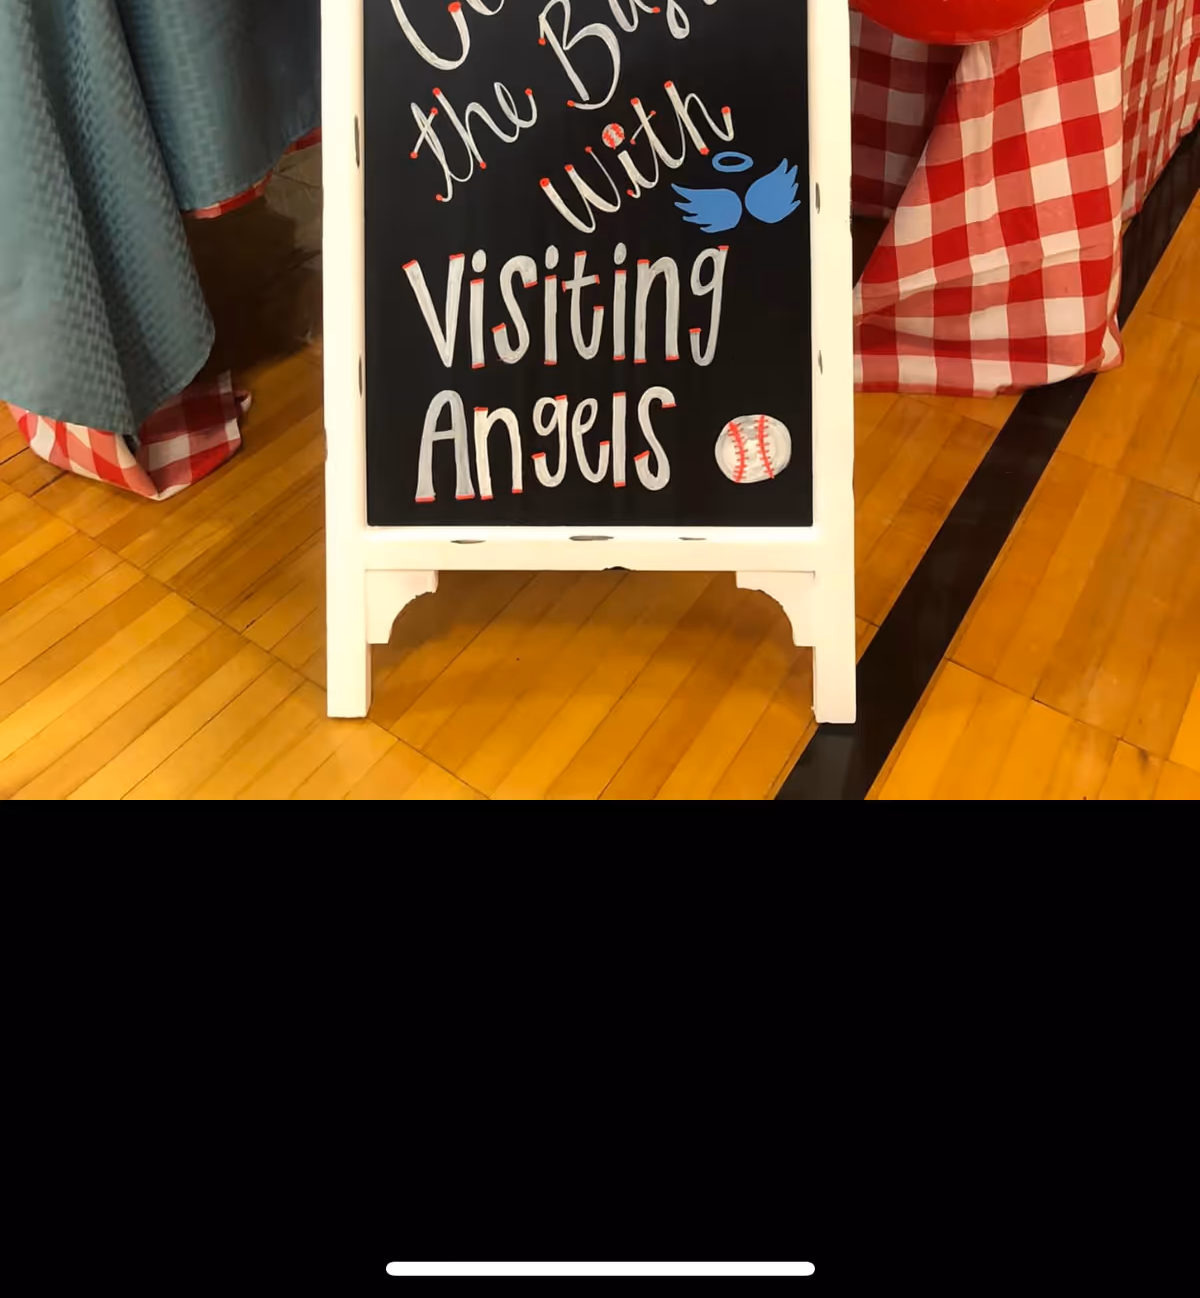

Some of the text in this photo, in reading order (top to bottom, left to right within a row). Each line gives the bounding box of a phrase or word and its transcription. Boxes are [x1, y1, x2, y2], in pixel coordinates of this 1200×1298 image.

[410, 82, 537, 202] the
[402, 242, 729, 368] Visiting
[415, 386, 676, 502] Angels
